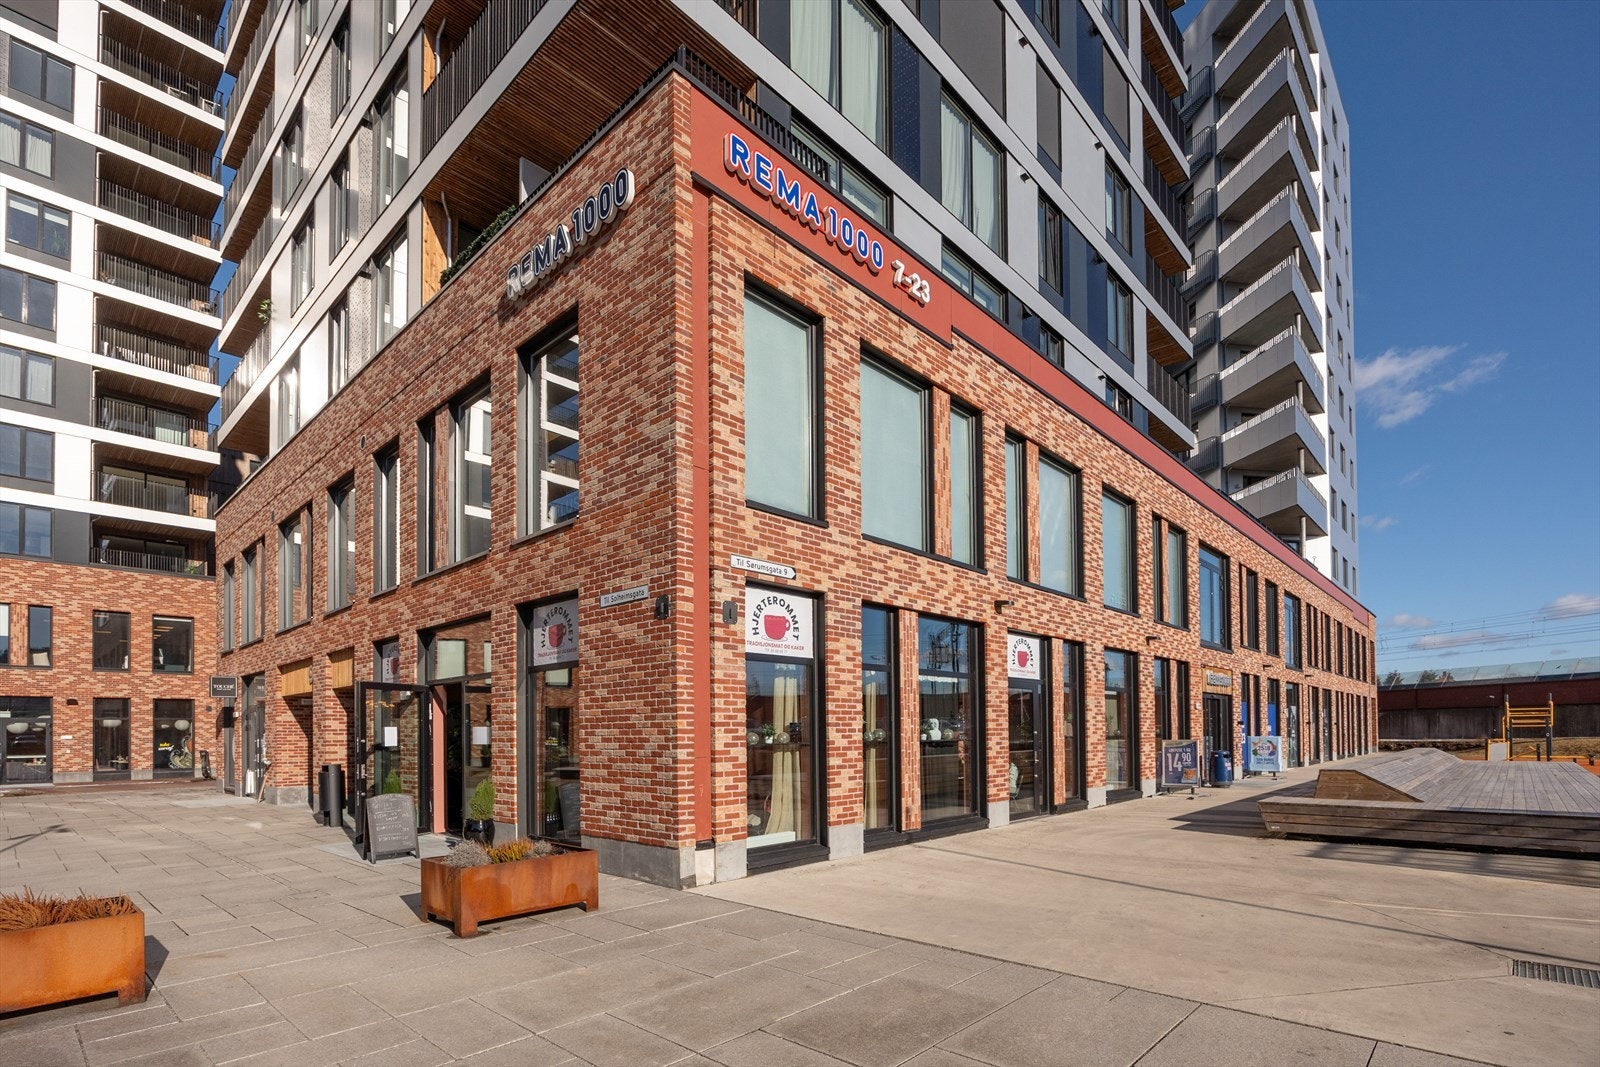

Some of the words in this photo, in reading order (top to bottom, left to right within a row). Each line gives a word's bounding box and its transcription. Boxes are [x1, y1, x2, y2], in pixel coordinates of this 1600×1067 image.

[507, 223, 571, 299] REMA
[572, 167, 634, 243] 1000
[727, 133, 821, 229] REMA
[825, 205, 884, 271] 1000
[891, 259, 931, 303] 7-23
[746, 560, 782, 575] Sørumsgata
[610, 589, 645, 603] Solheimsgata
[751, 595, 800, 641] HJERTEROMMET
[540, 606, 574, 649] HJERTEROMMET
